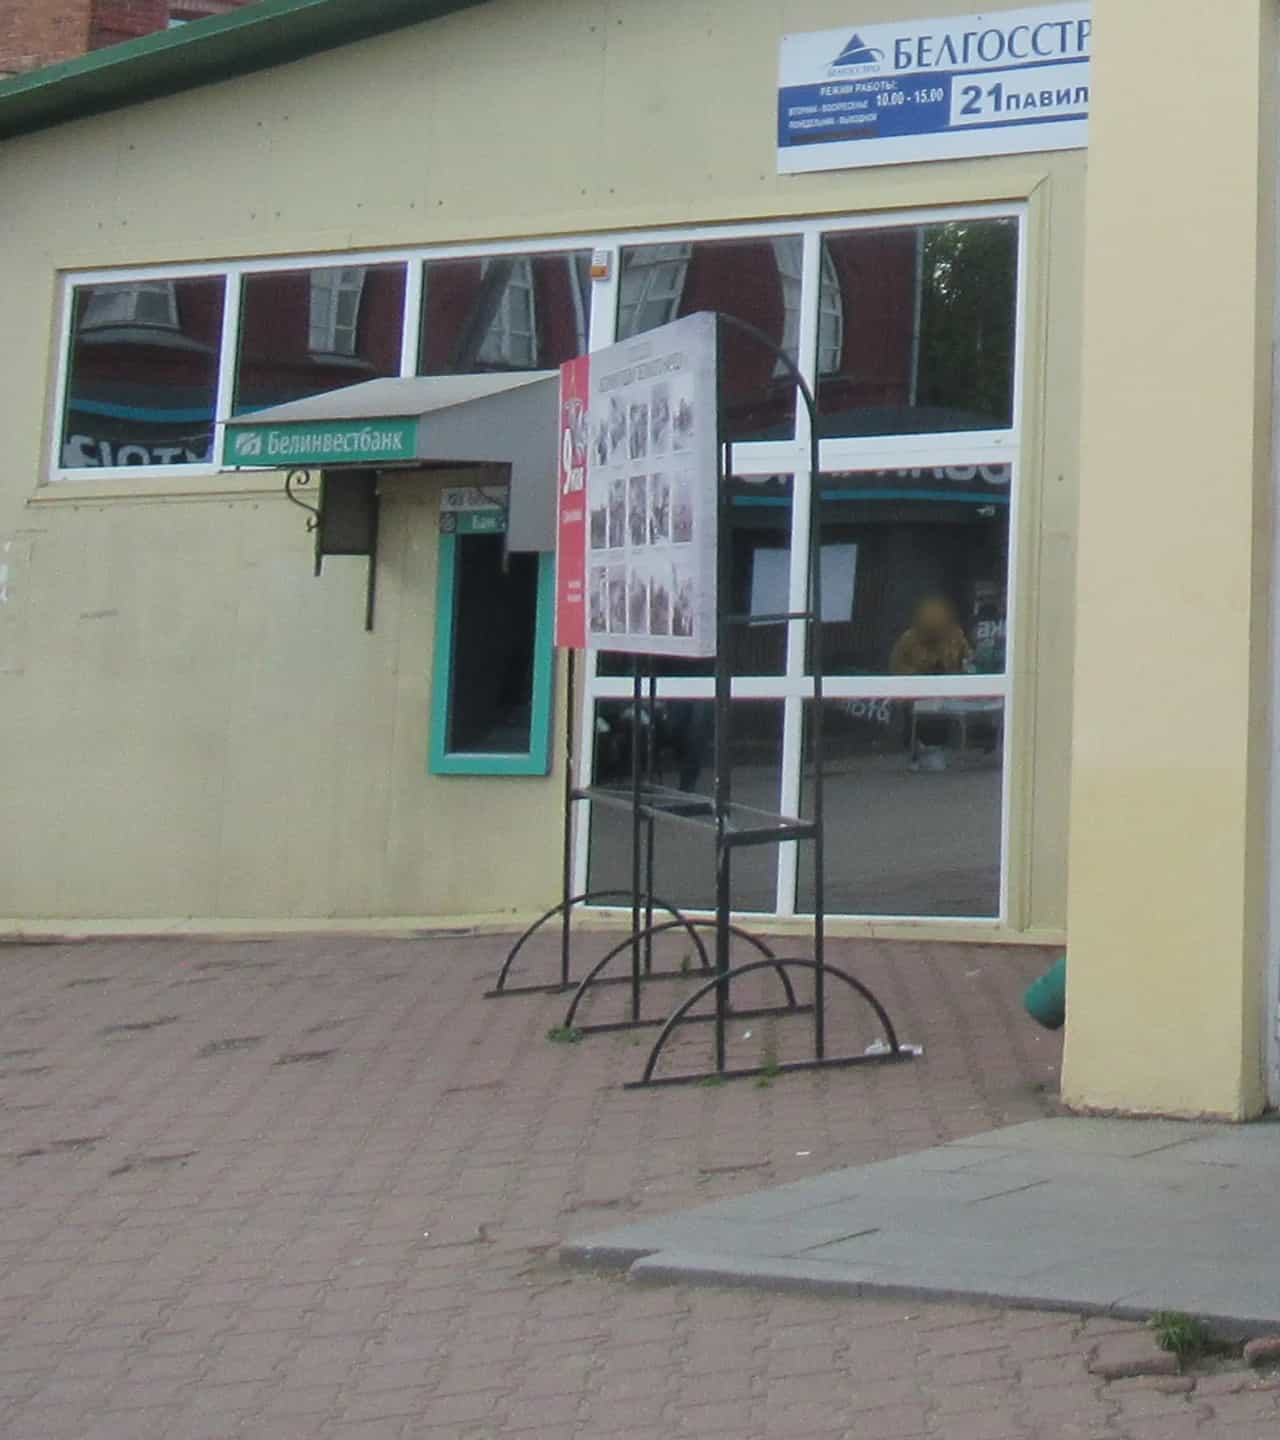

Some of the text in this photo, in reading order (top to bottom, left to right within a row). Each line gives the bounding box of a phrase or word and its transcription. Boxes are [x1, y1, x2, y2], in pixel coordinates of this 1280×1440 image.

[915, 88, 944, 103] 15.00
[960, 82, 1002, 115] 21
[268, 427, 402, 455] Белинвестбанк
